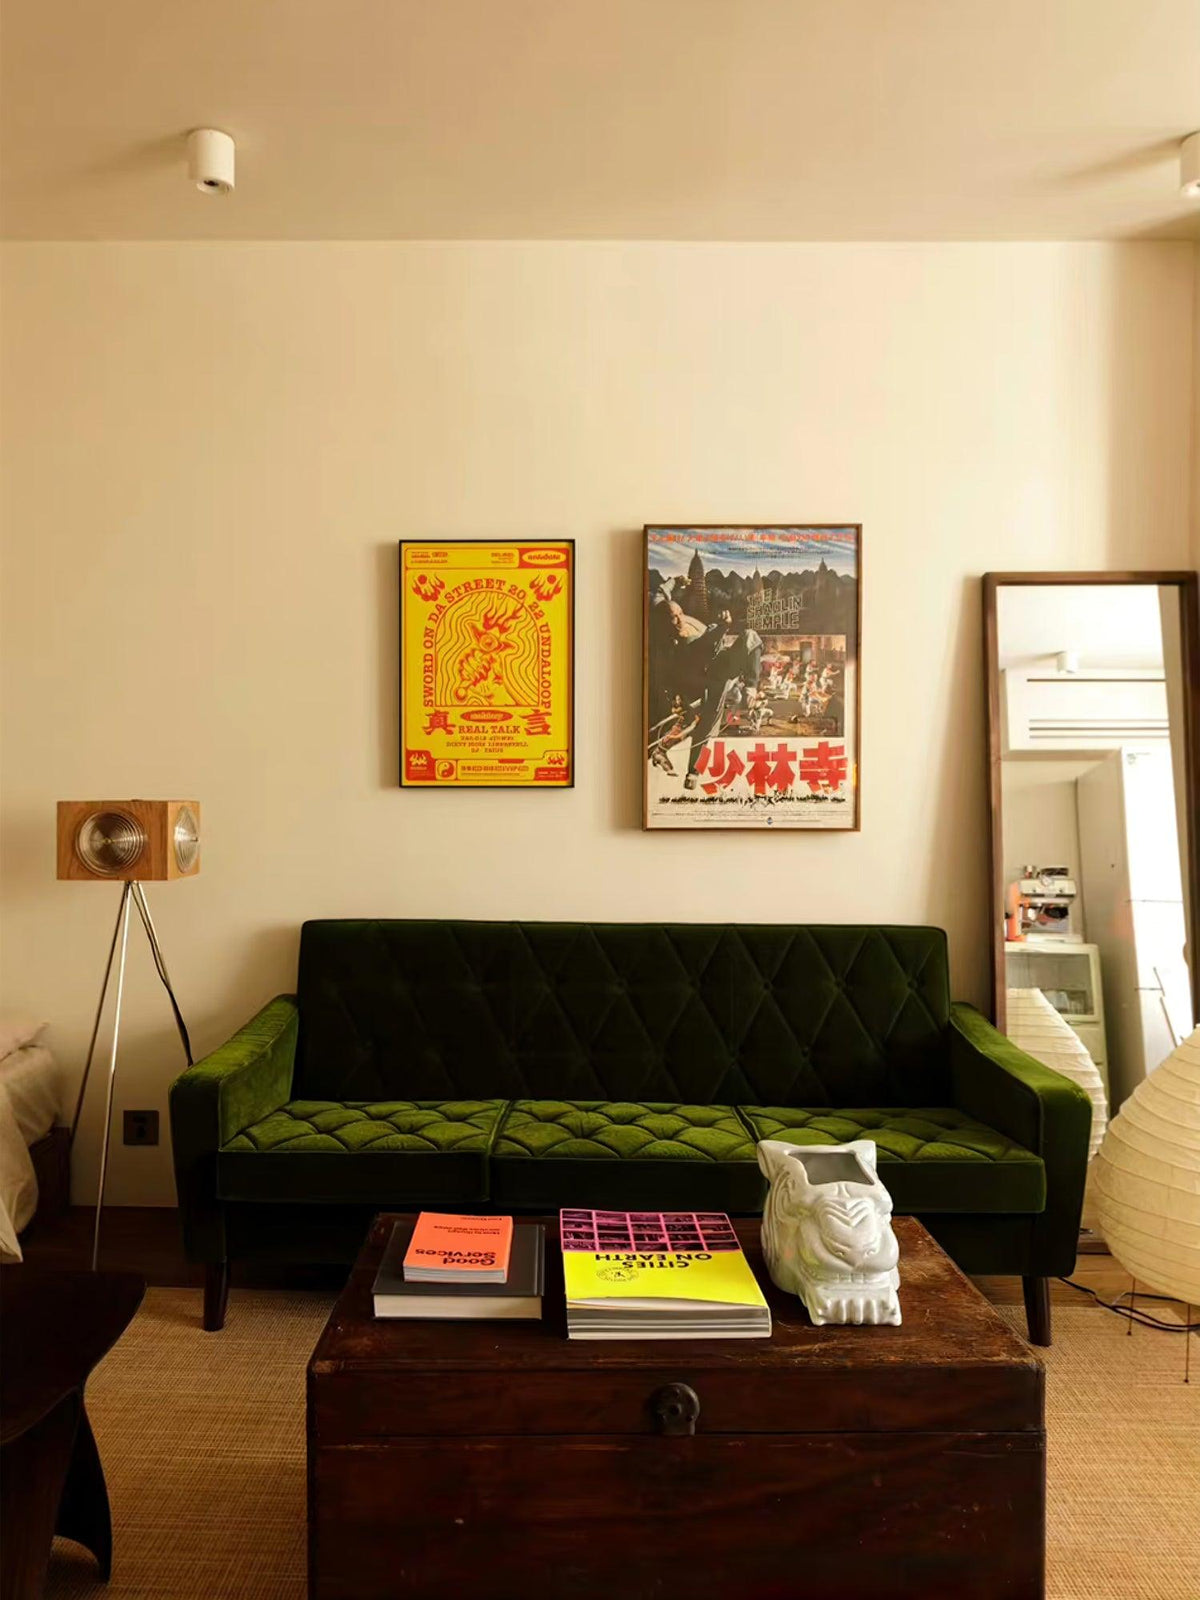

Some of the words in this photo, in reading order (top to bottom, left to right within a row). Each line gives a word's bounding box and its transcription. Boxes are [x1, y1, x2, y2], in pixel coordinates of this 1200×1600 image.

[444, 578, 506, 604] STREET
[428, 604, 446, 624] DA
[423, 626, 435, 649] ON
[539, 622, 551, 709] UNDALOOP
[423, 653, 434, 707] SWORD
[458, 725, 488, 734] REAL
[491, 725, 520, 734] TALK
[519, 708, 552, 736] 言
[694, 741, 848, 795] 少林寺
[415, 1249, 496, 1259] Services
[443, 1257, 495, 1266] Good
[595, 1253, 667, 1261] EARTH
[675, 1253, 712, 1261] ON
[622, 1261, 690, 1269] CITIES
